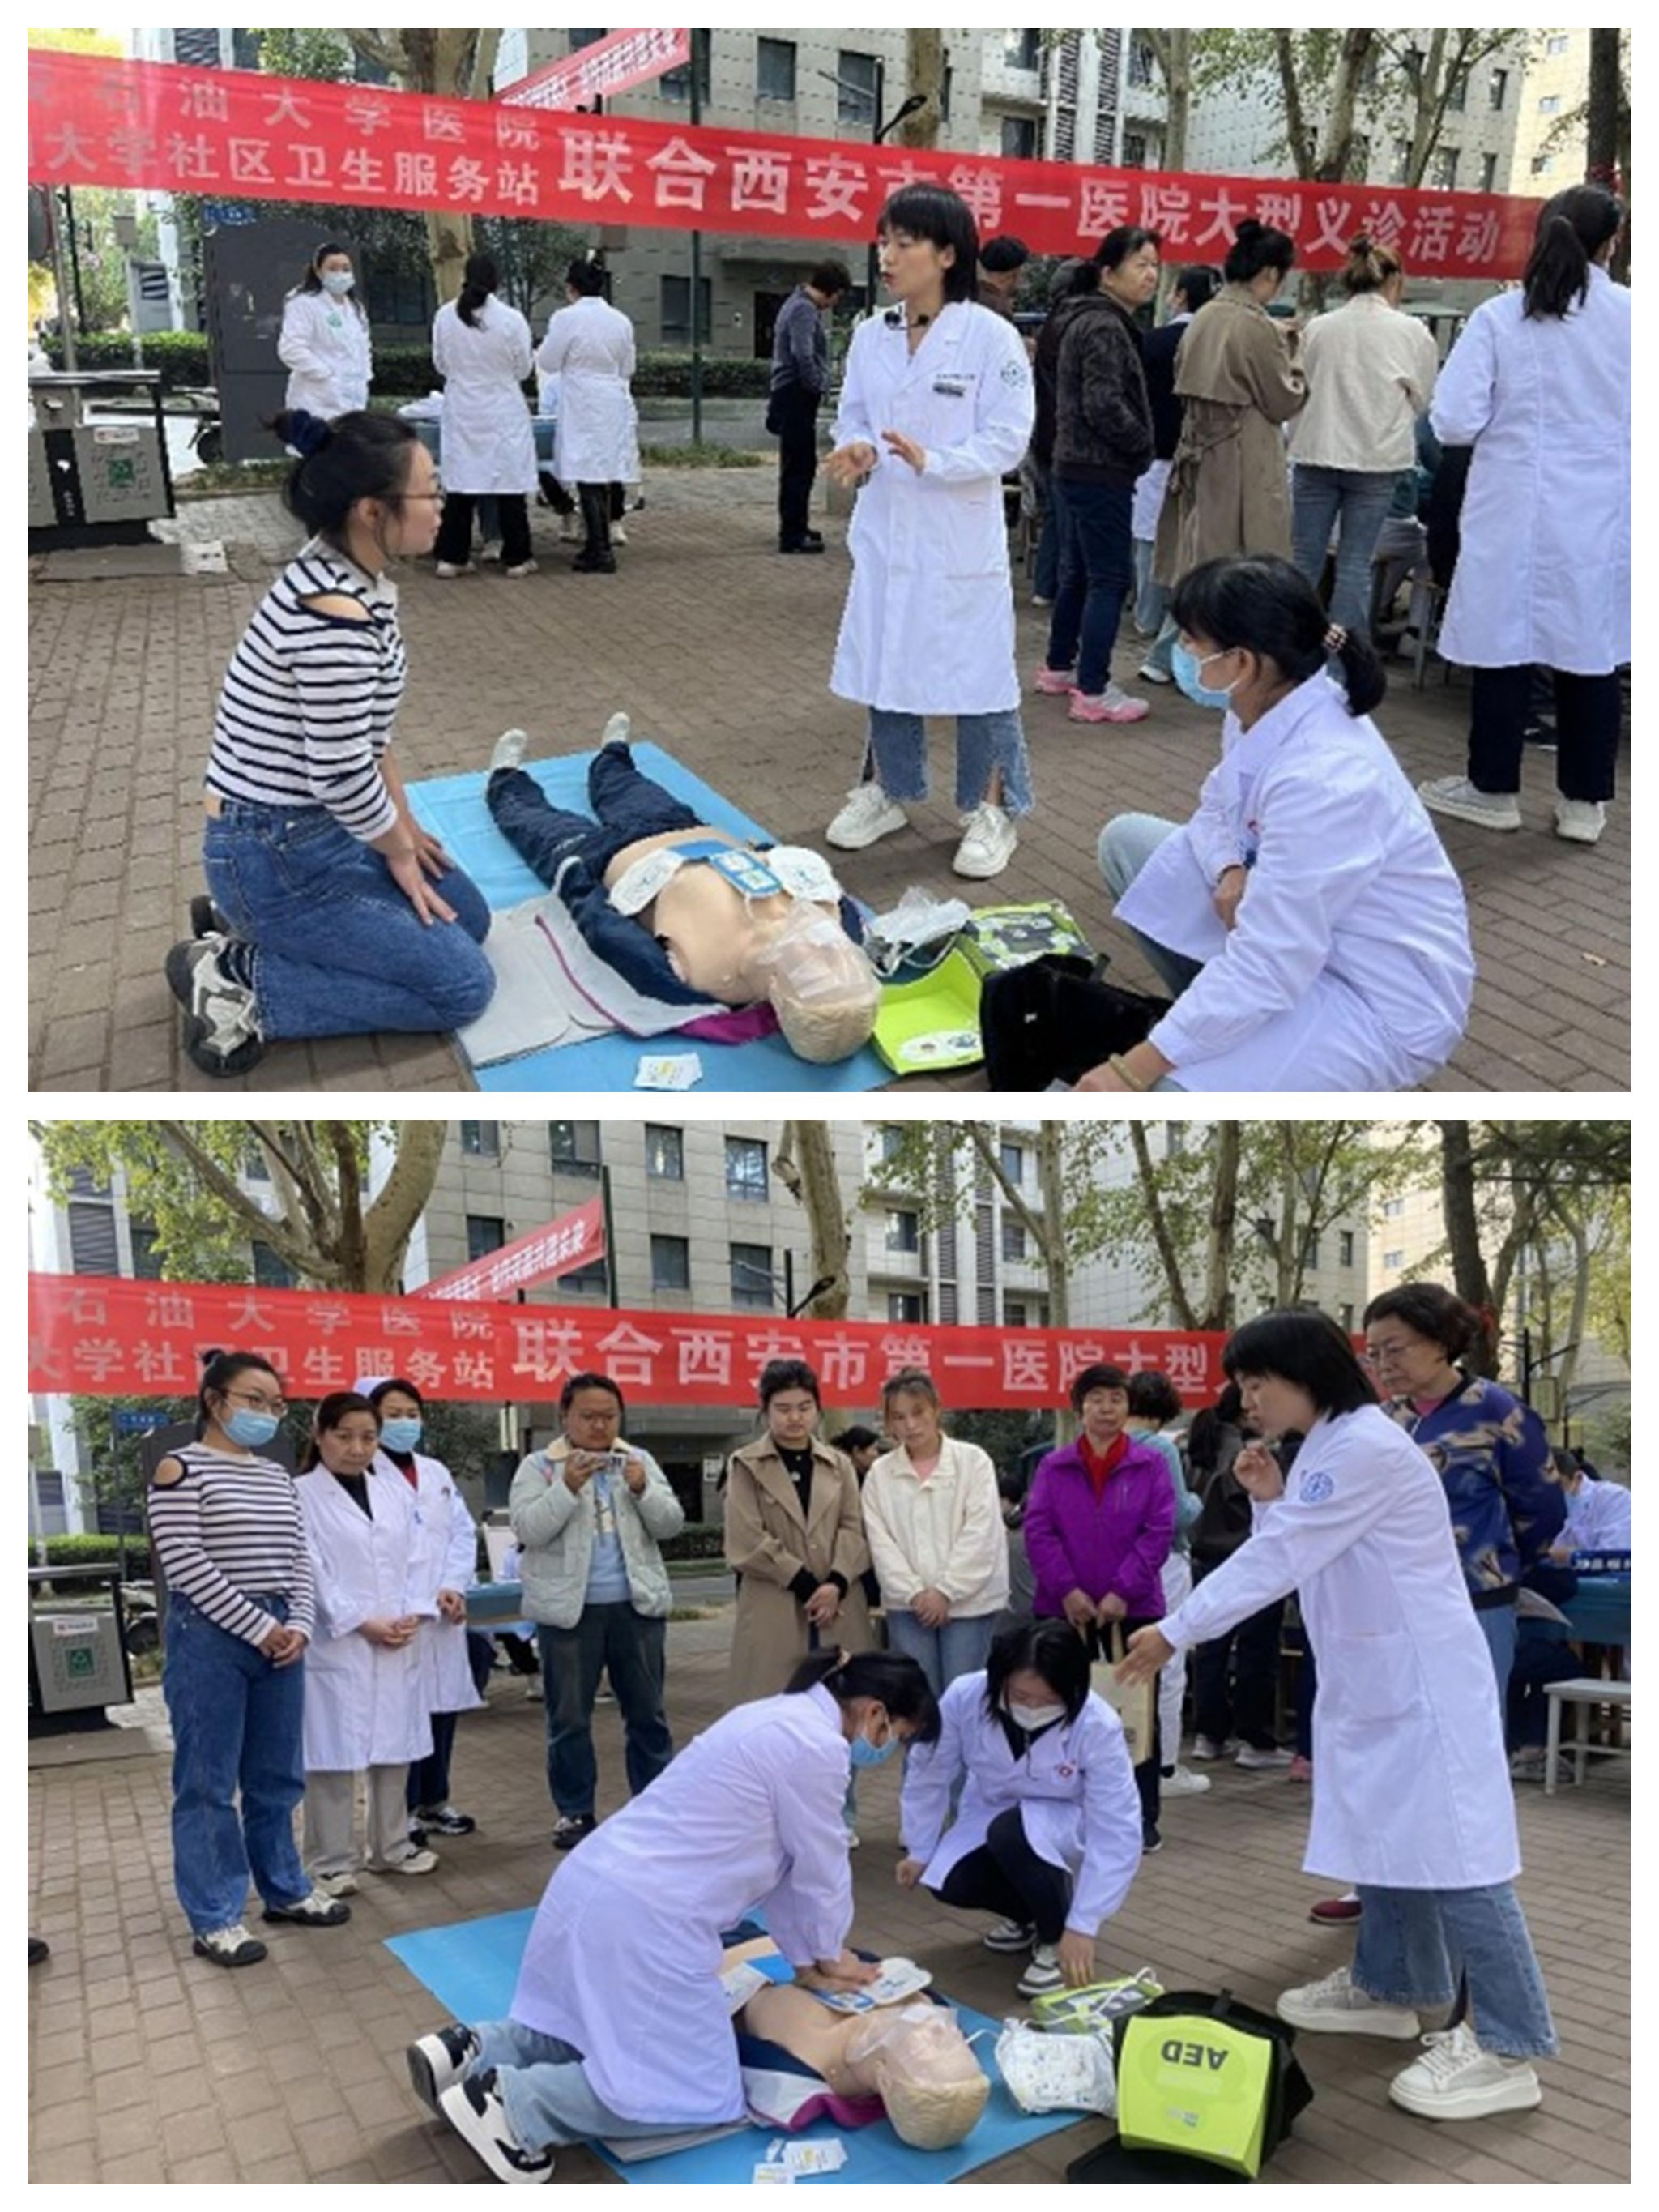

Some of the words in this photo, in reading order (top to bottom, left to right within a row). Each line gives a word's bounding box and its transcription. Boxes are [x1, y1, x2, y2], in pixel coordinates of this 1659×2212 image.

[28, 121, 539, 206] 大学社区卫生服务站
[510, 1317, 1233, 1395] 联合西安市第一医院大型
[1161, 2039, 1230, 2071] AED
